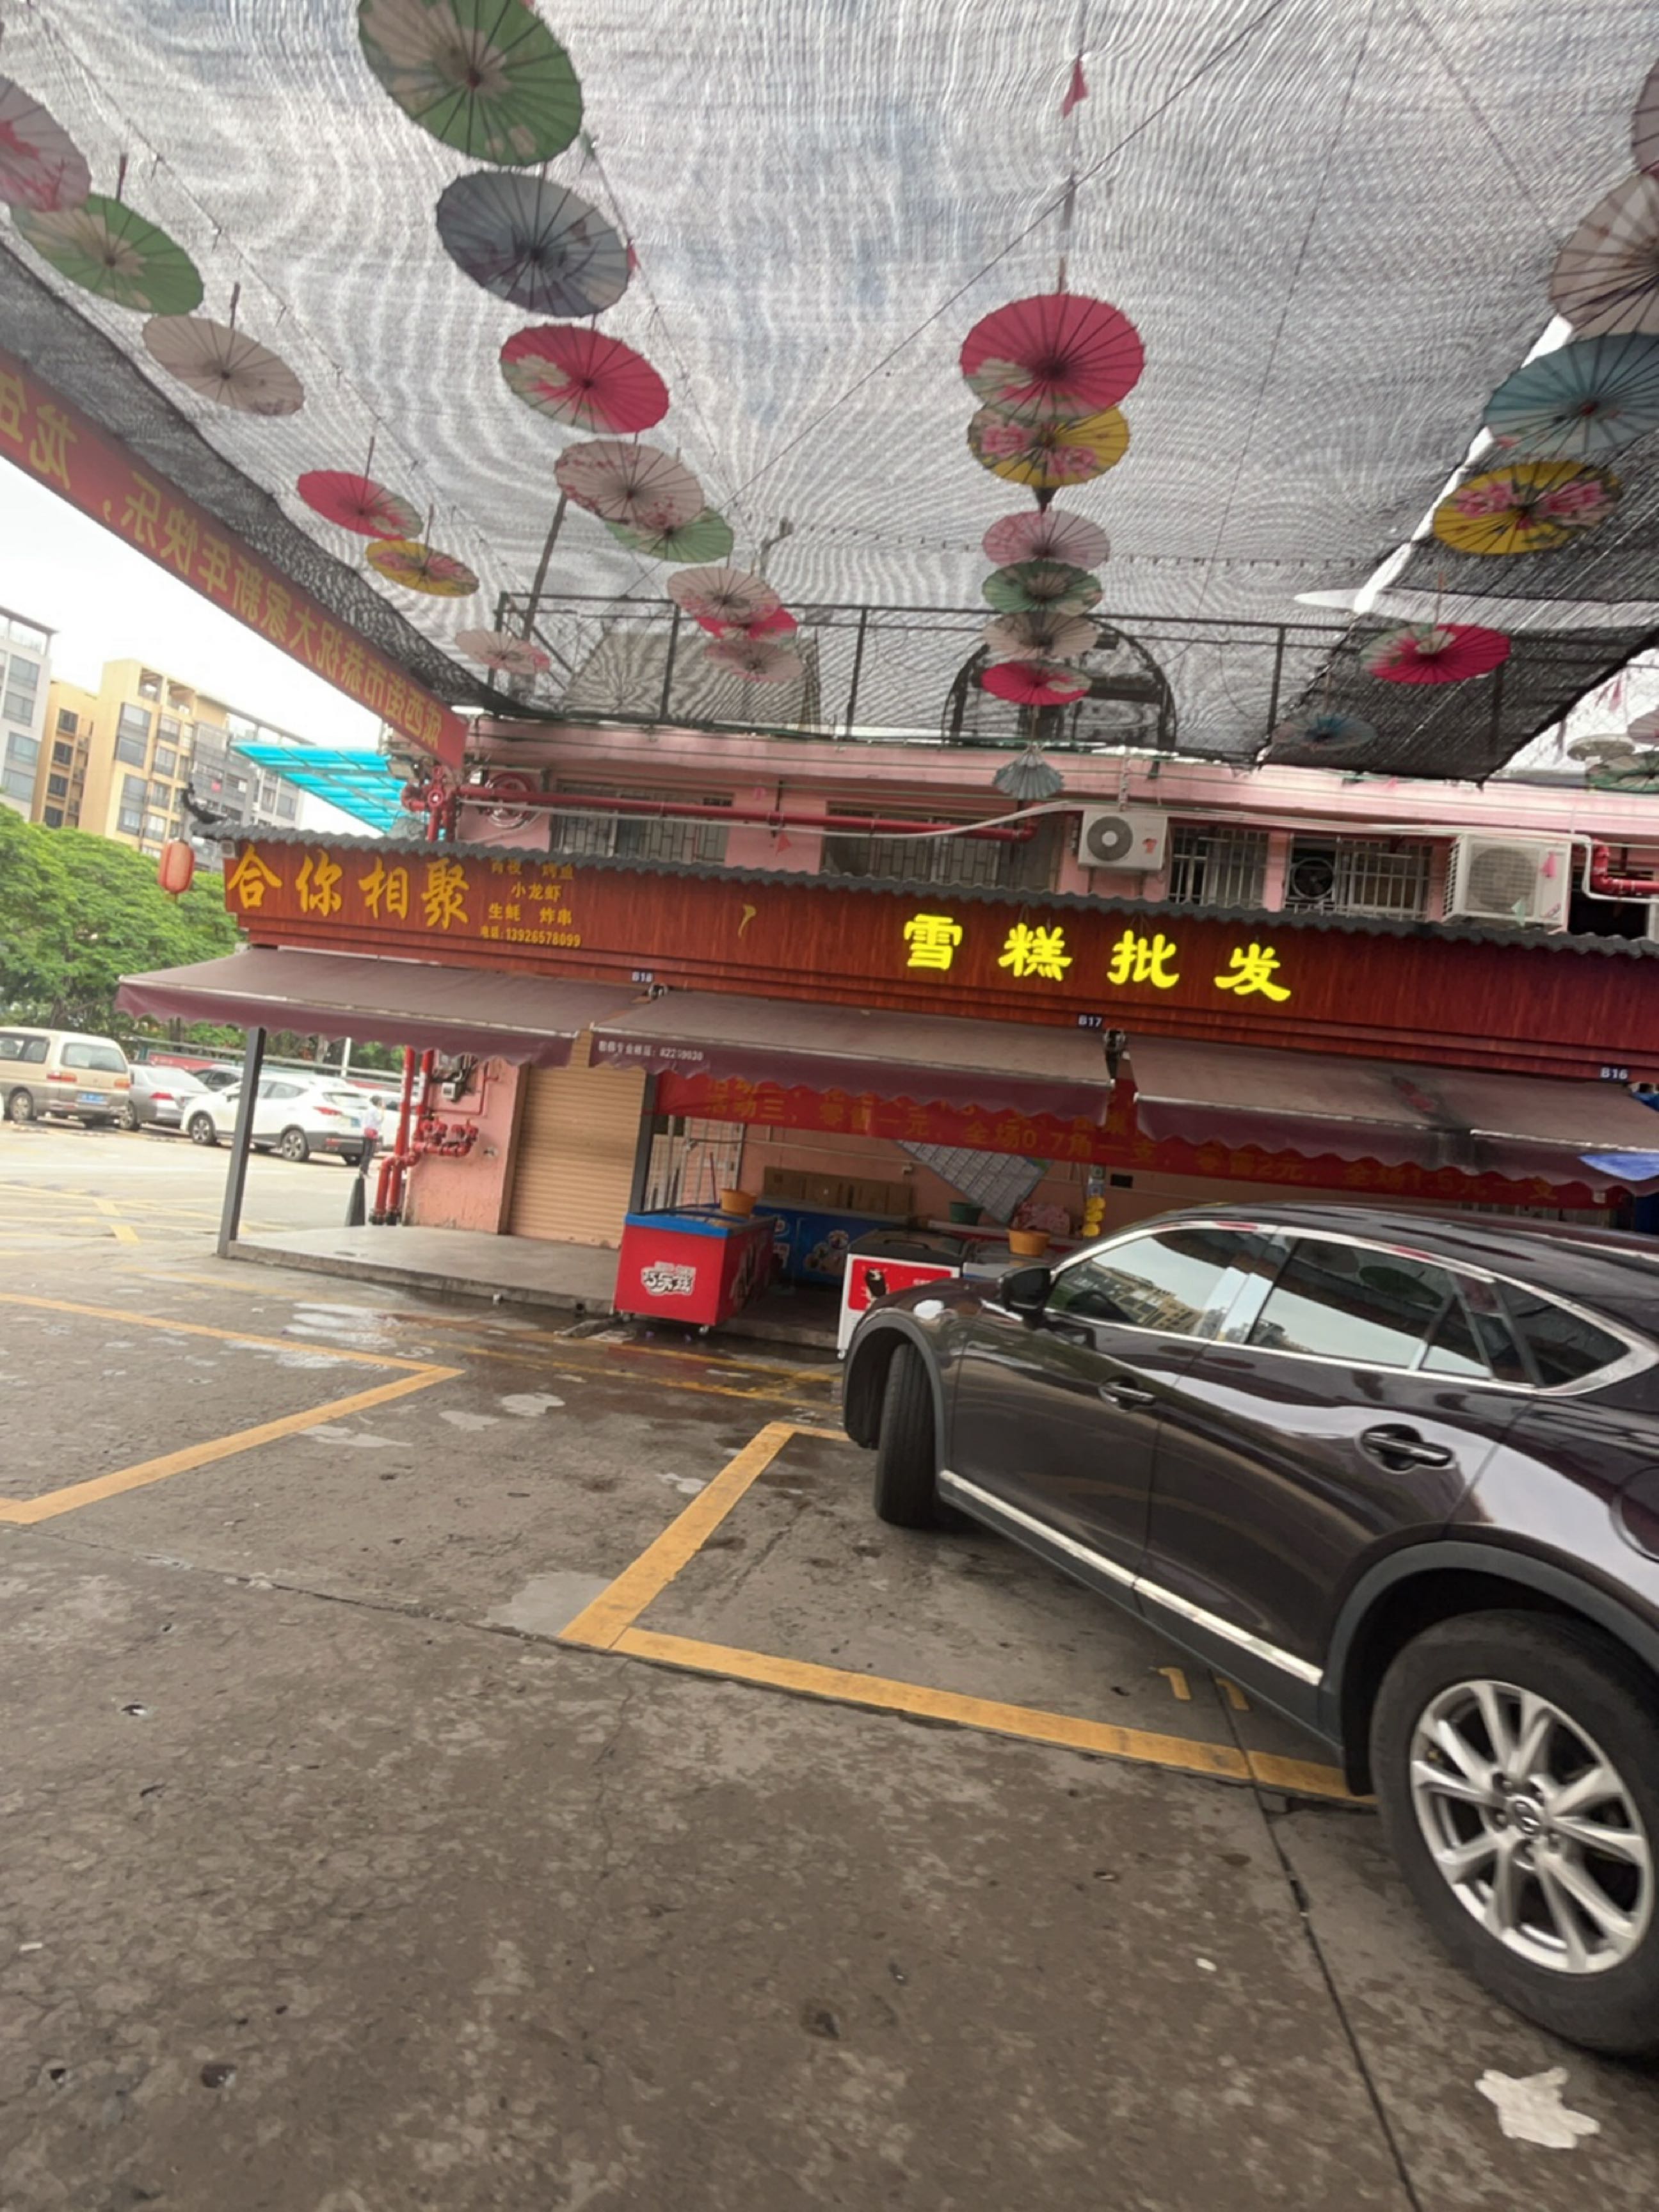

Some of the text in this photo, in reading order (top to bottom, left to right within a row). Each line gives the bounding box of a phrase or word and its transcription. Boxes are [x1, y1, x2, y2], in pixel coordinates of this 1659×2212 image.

[227, 844, 470, 930] 合你相聚
[511, 881, 561, 902] 小龙虾
[488, 902, 572, 926] 生蚝 炸串
[903, 913, 1291, 1002] 雪糕批发
[1078, 1014, 1102, 1027] B17
[1601, 1067, 1628, 1080] B16
